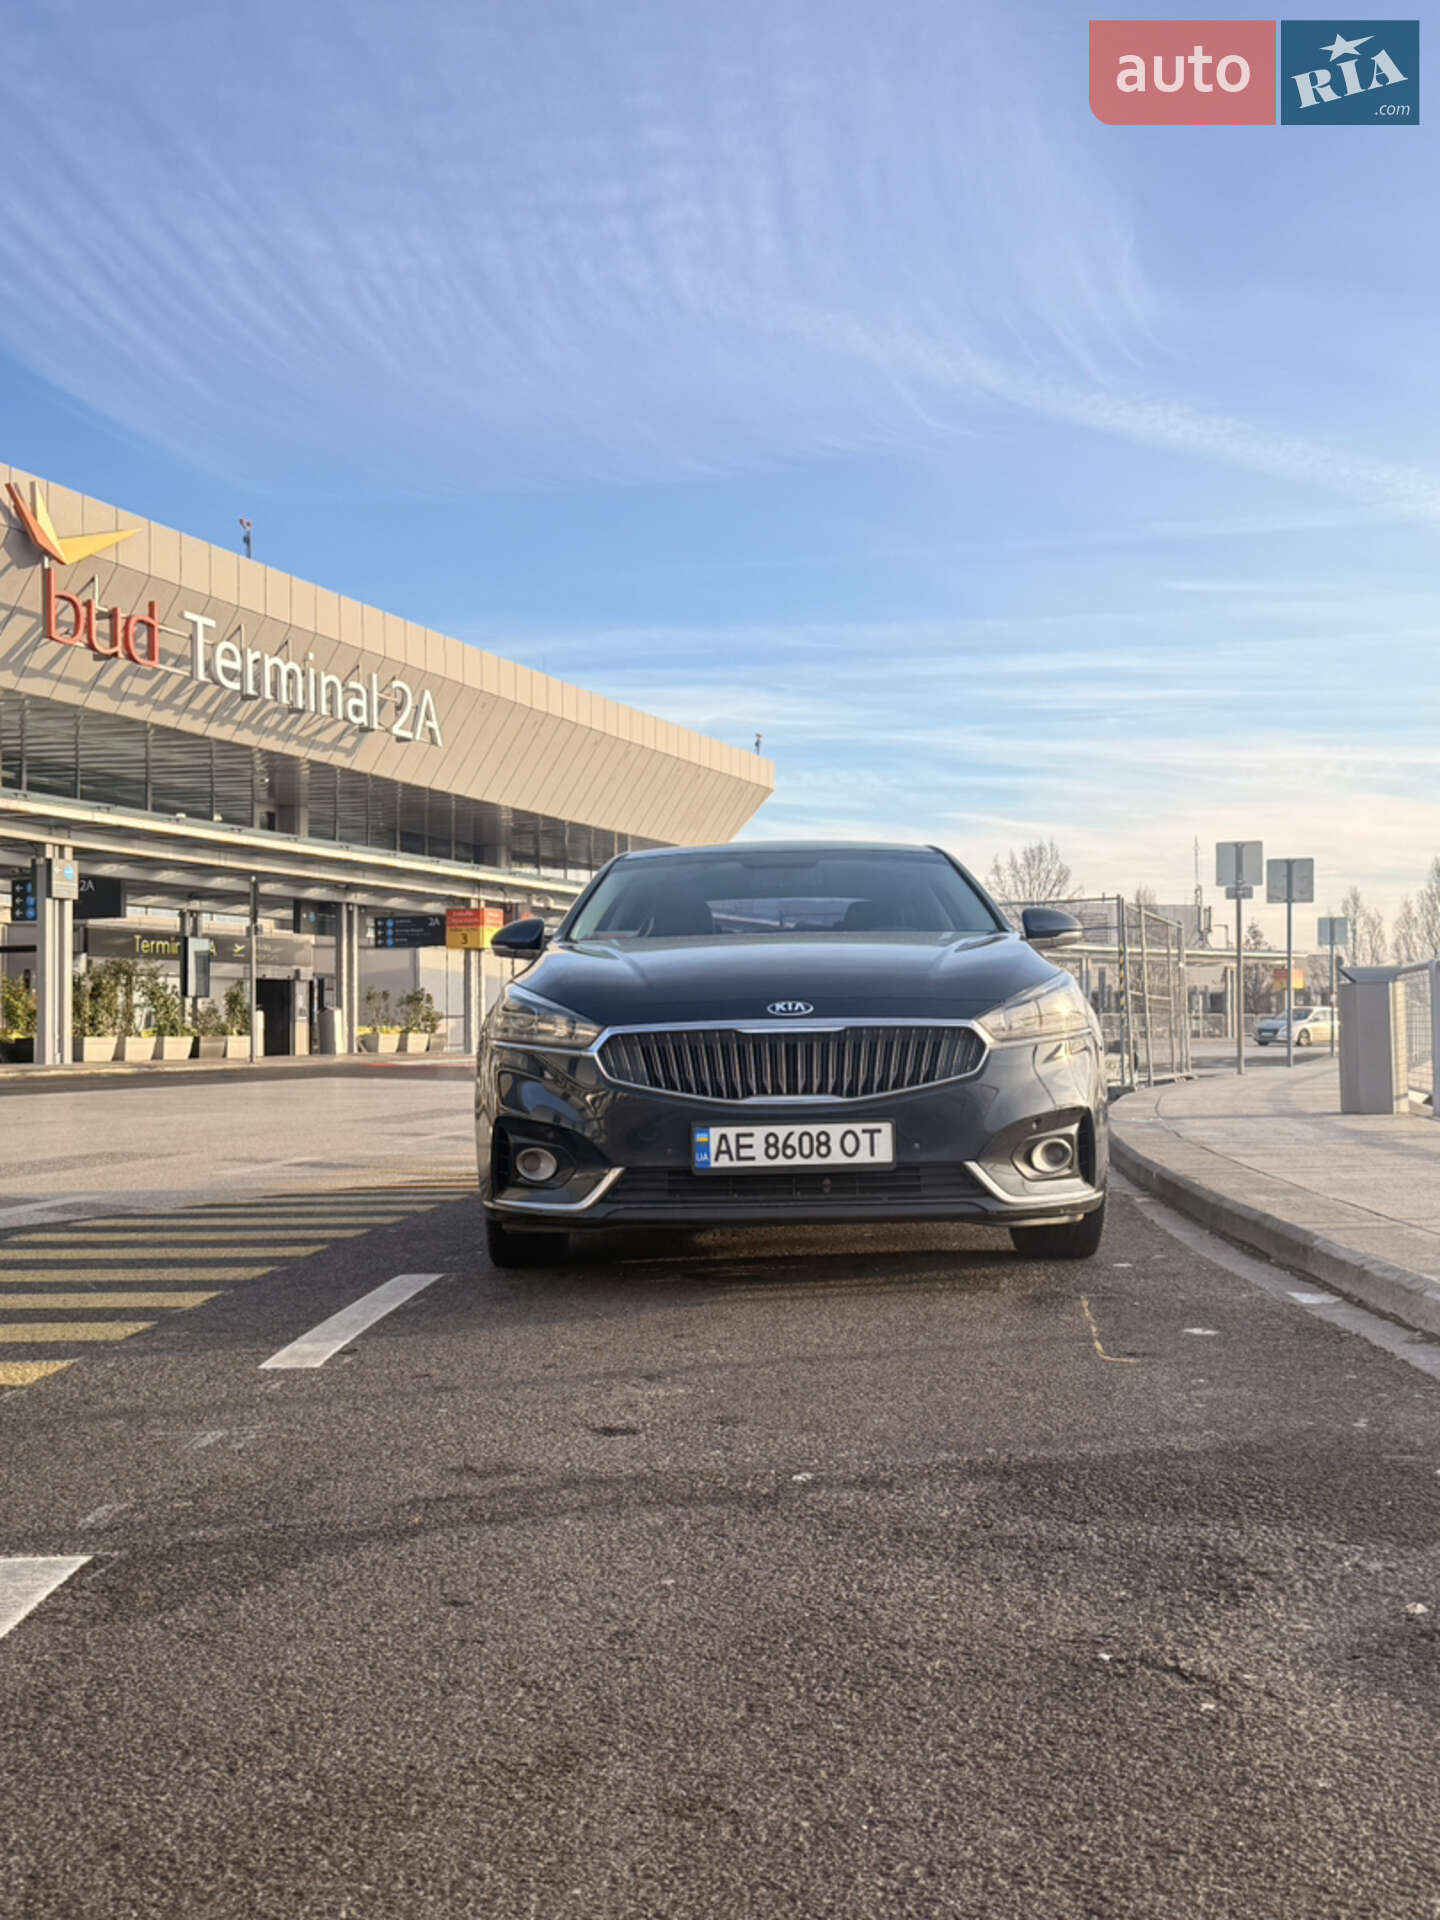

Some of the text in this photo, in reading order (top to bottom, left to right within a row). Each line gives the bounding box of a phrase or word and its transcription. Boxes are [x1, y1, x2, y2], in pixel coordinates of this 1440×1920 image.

[45, 567, 160, 668] bud
[183, 610, 443, 747] Terminal 2A
[79, 879, 96, 892] 2A
[695, 1152, 709, 1163] UA
[714, 1128, 882, 1162] AE 8608 OT
